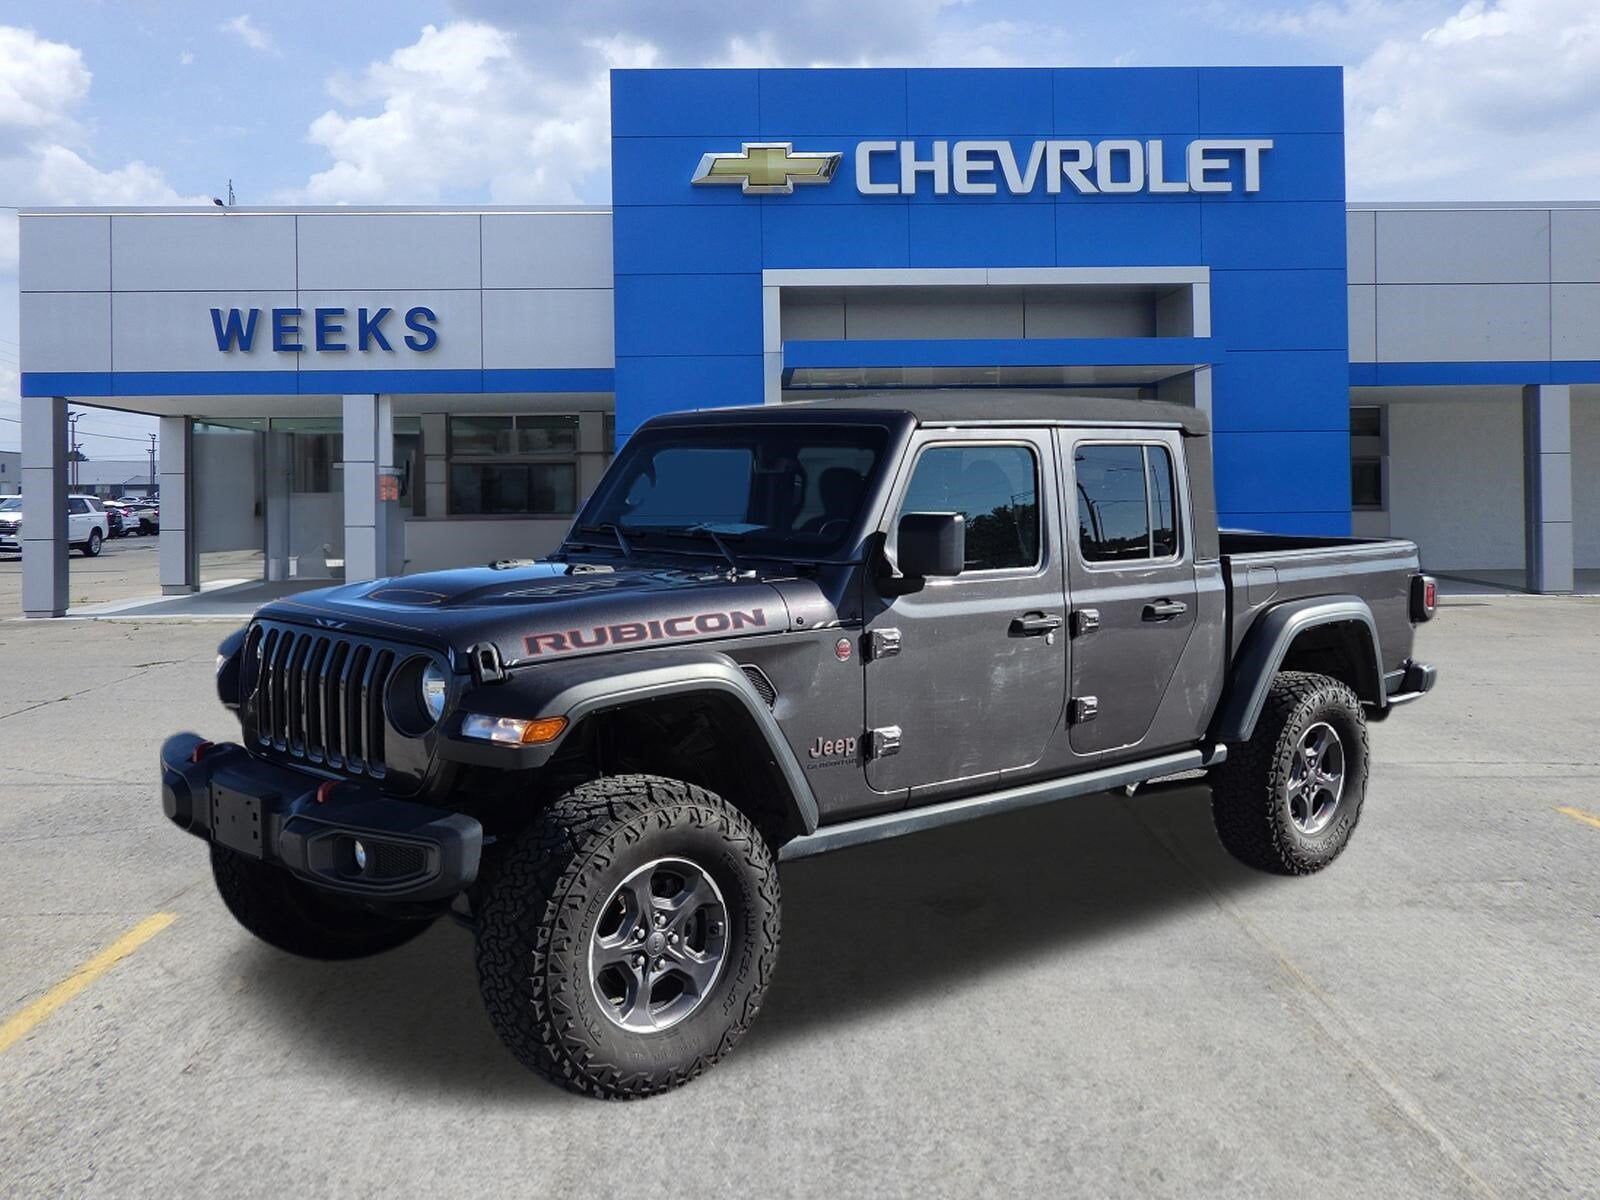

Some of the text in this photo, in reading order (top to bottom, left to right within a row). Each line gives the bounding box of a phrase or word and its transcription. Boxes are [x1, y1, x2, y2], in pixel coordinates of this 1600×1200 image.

[855, 138, 1274, 195] CHEVROLET
[209, 306, 438, 353] WEEKS
[524, 607, 767, 656] RUBICON
[808, 736, 856, 759] Jeep
